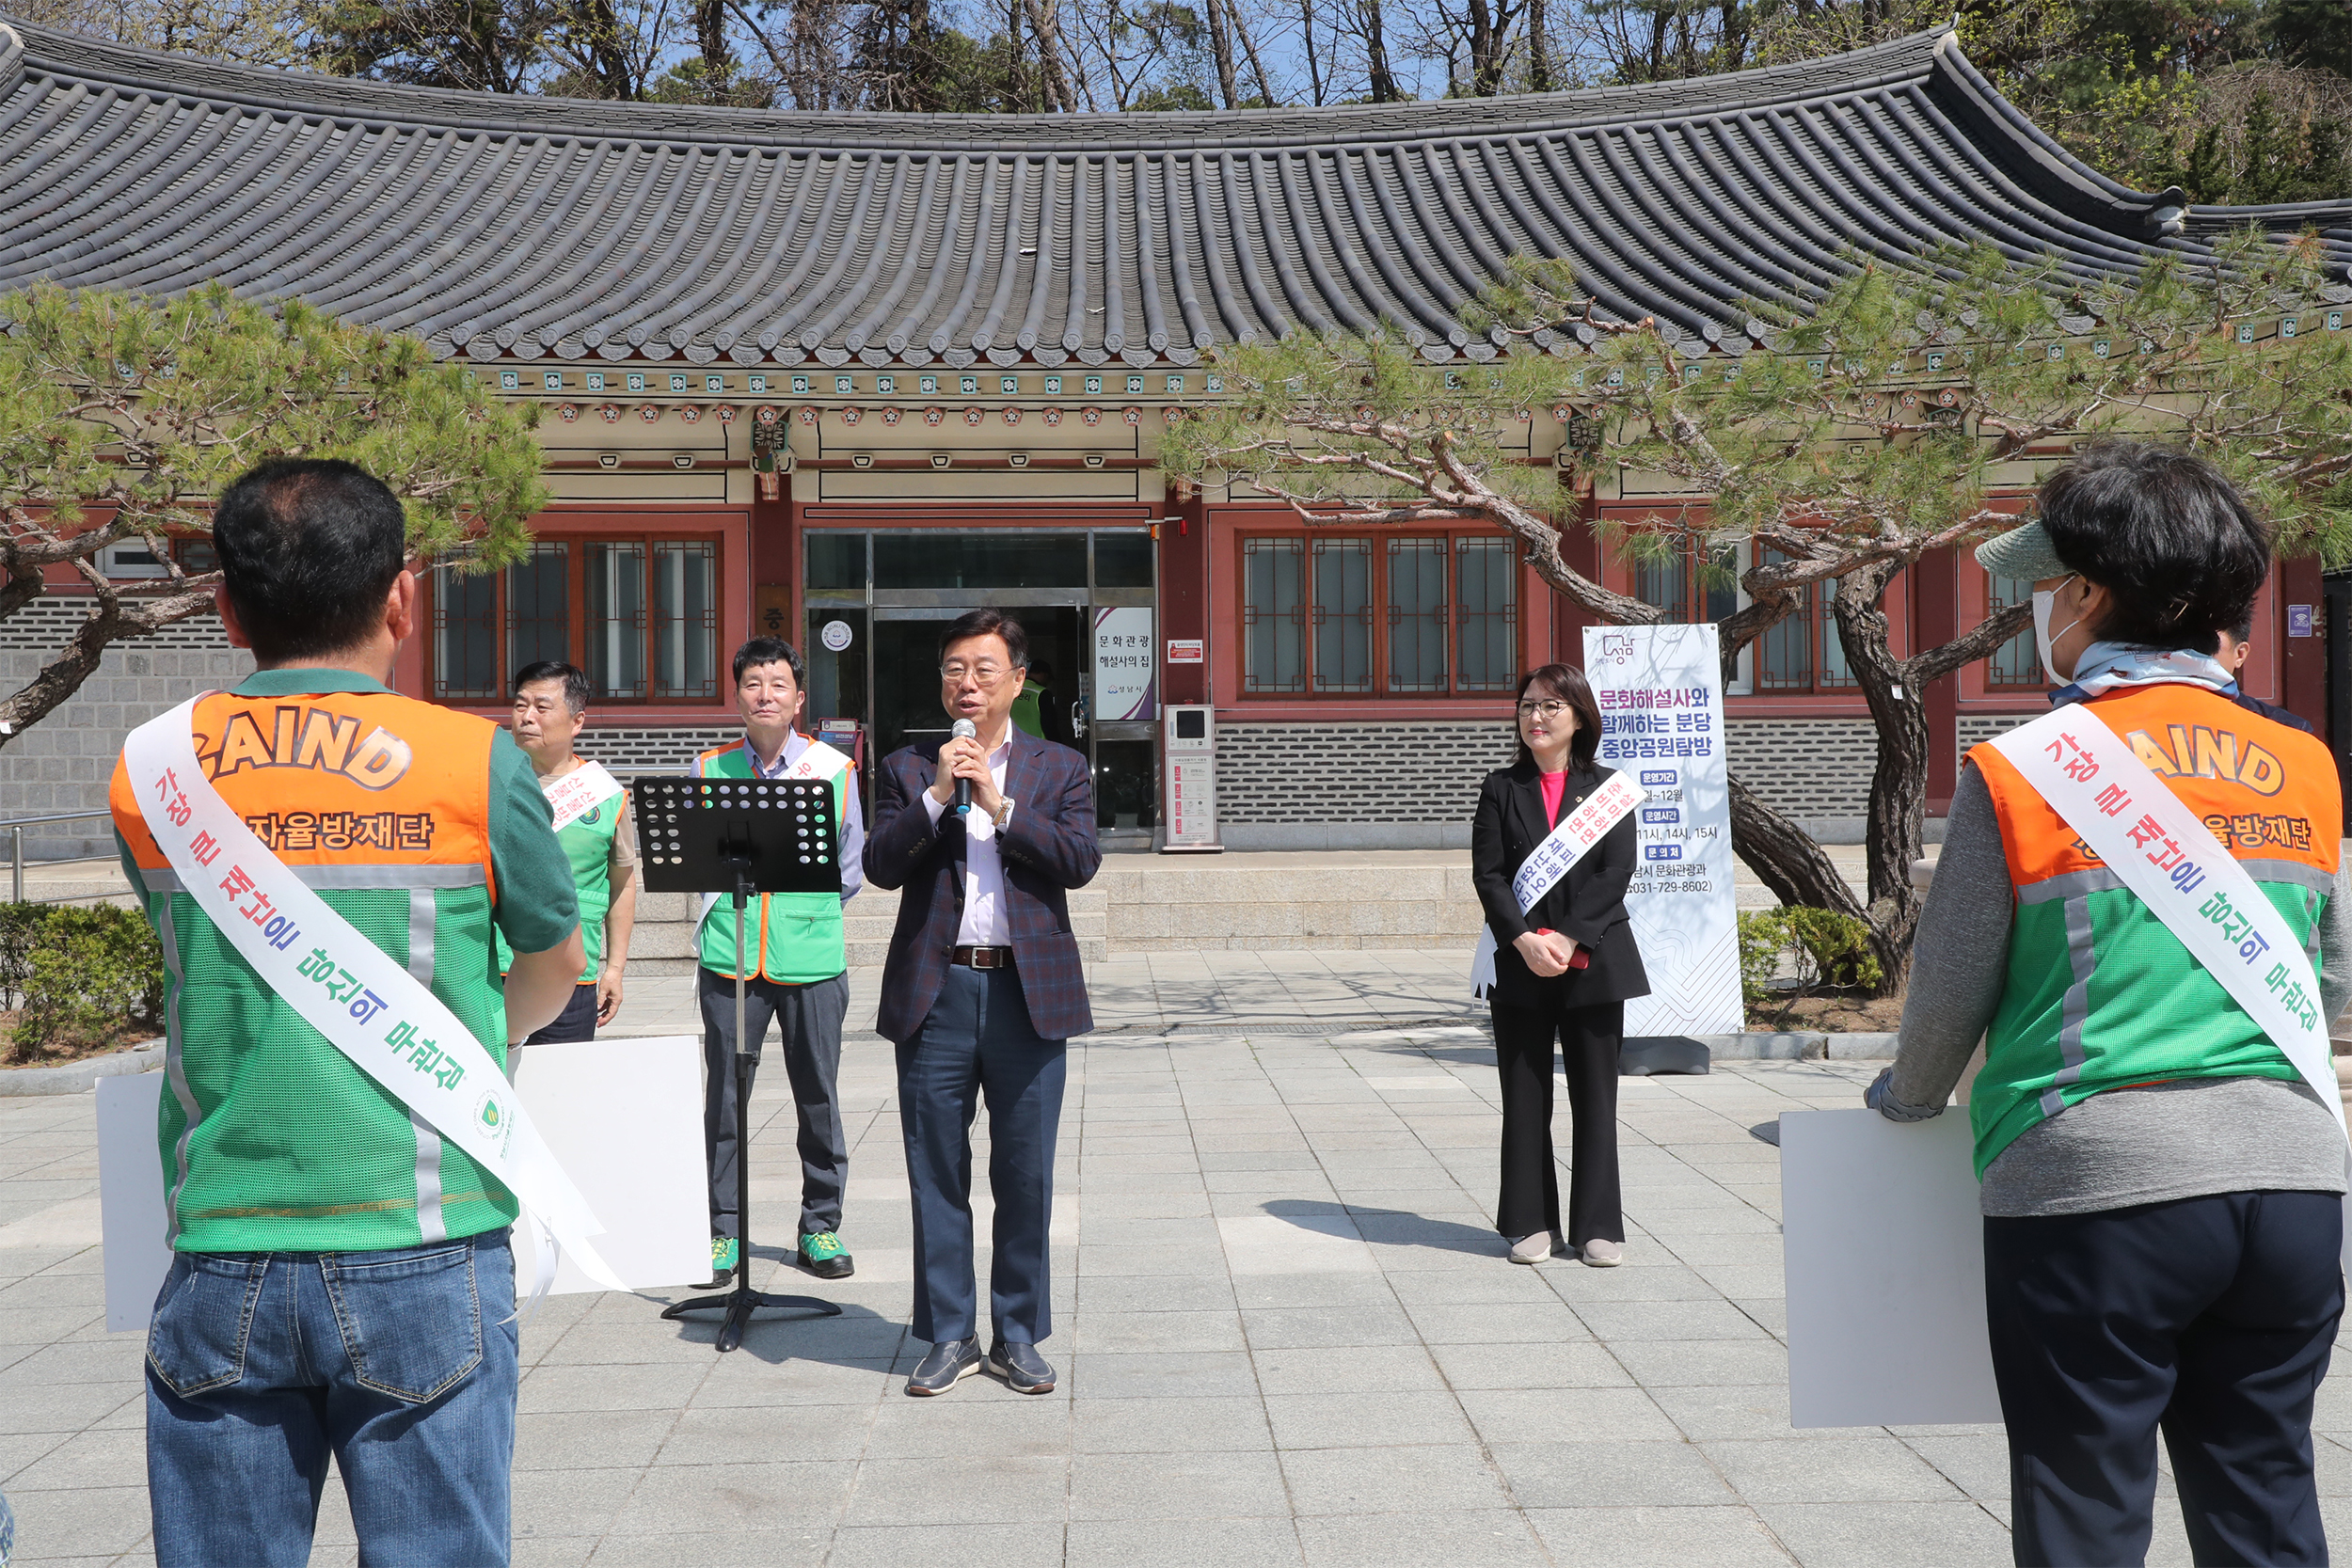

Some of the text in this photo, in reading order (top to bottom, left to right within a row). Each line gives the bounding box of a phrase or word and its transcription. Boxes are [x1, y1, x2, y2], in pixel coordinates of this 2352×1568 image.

[763, 608, 785, 636] 중
[1099, 635, 1150, 647] 문화관광
[1099, 656, 1150, 668] 해설사의 집
[1599, 688, 1709, 710] 문화해설사와
[1600, 712, 1711, 735] 함께하는 분당
[1602, 736, 1712, 759] 중앙공원탐방
[1643, 772, 1675, 784] 운영기간
[551, 791, 596, 827] 산불방
[1645, 810, 1677, 821] 운영시간
[246, 812, 435, 851] 자율방재단
[1514, 782, 1624, 897] 준비하면 재난없다
[1665, 827, 1692, 840] 14시,
[1694, 827, 1718, 839] 15시
[2202, 813, 2312, 852] 율방재단
[1520, 793, 1635, 908] 설마하면 피해오고
[1656, 863, 1707, 878] 문화관광과
[2044, 732, 2101, 783] 가장
[2093, 782, 2133, 817] 큰
[2125, 814, 2206, 895] 재난은
[2198, 891, 2270, 966] 당신의
[2264, 961, 2318, 1033] 무관심
[155, 767, 466, 1091] 가장 큰 재난은 당신의 무관심
